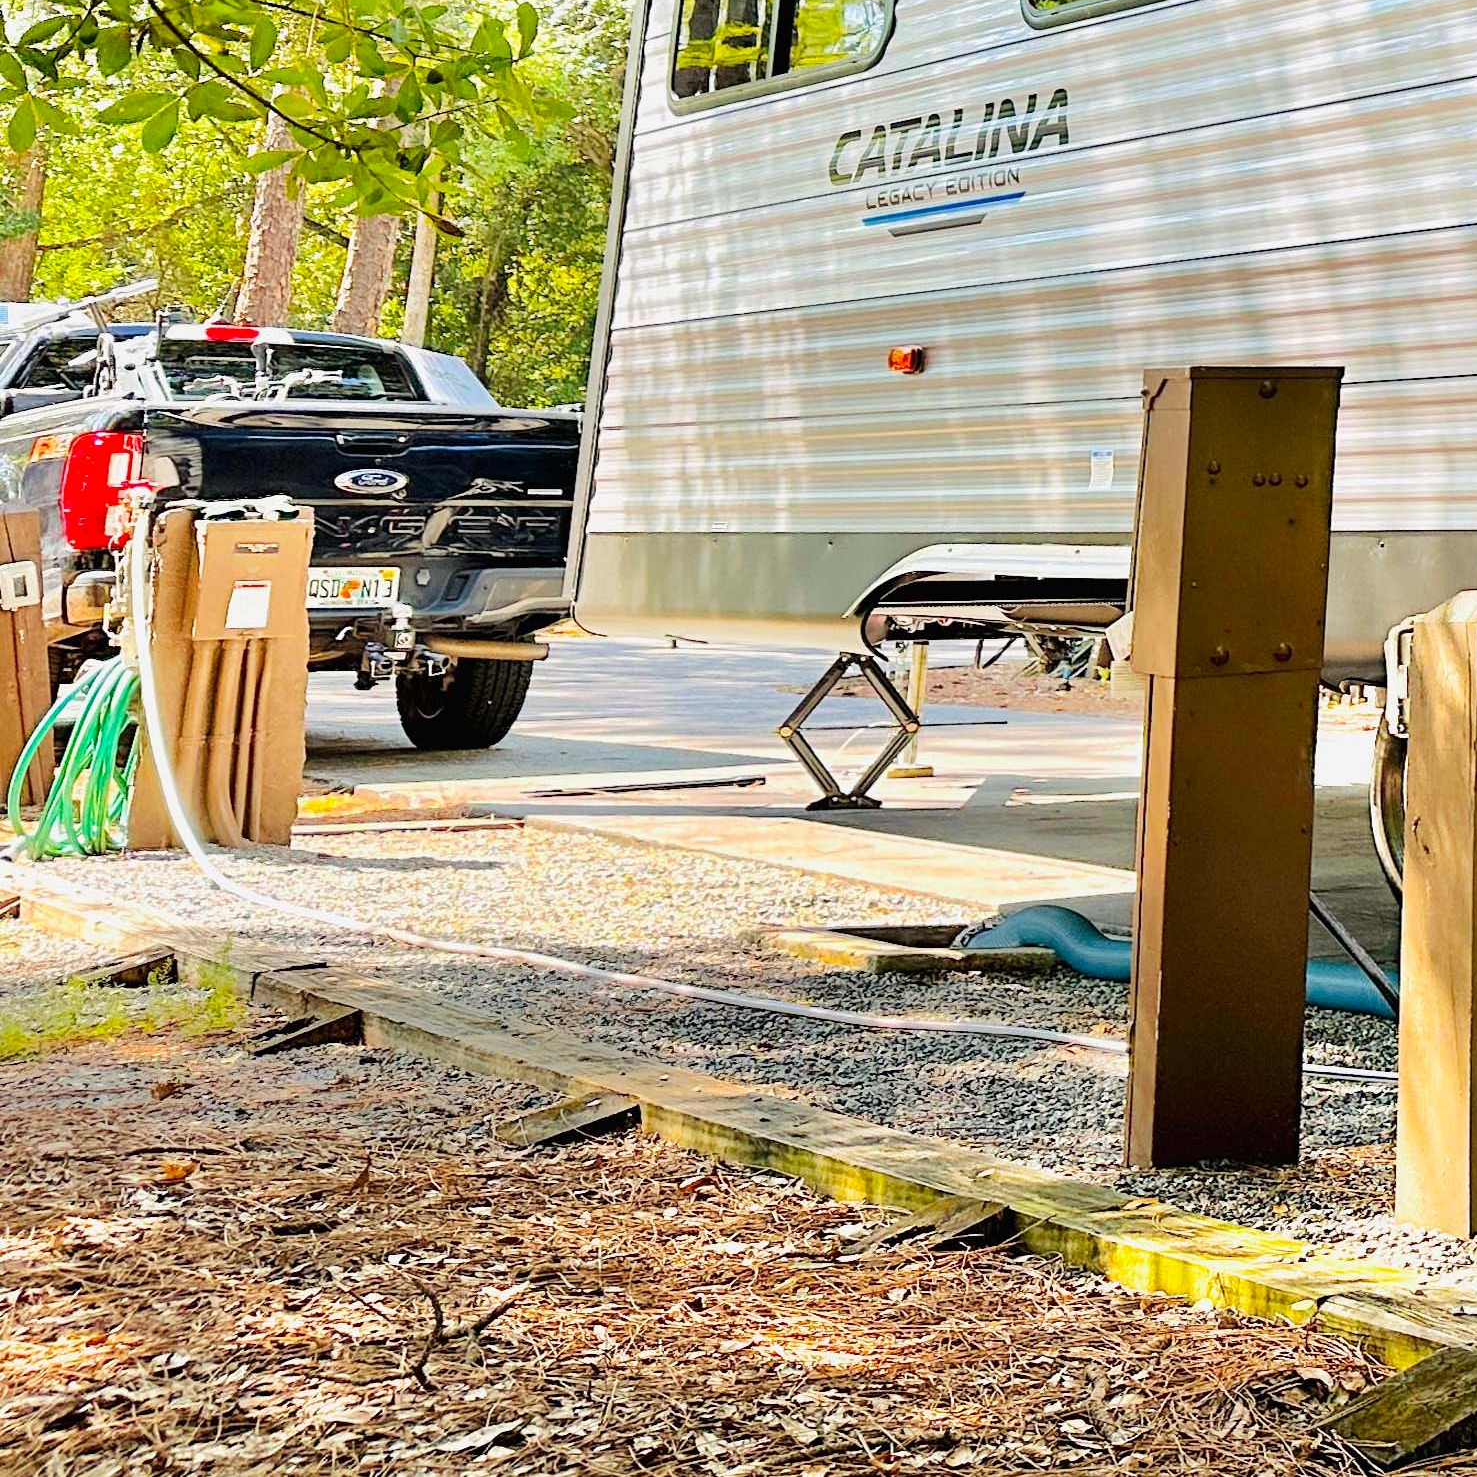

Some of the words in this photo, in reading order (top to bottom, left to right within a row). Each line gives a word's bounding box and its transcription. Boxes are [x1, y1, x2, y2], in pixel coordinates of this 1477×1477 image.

[828, 88, 1070, 186] CATALINA
[864, 180, 937, 210] LEGACY
[945, 167, 1021, 196] EDITION
